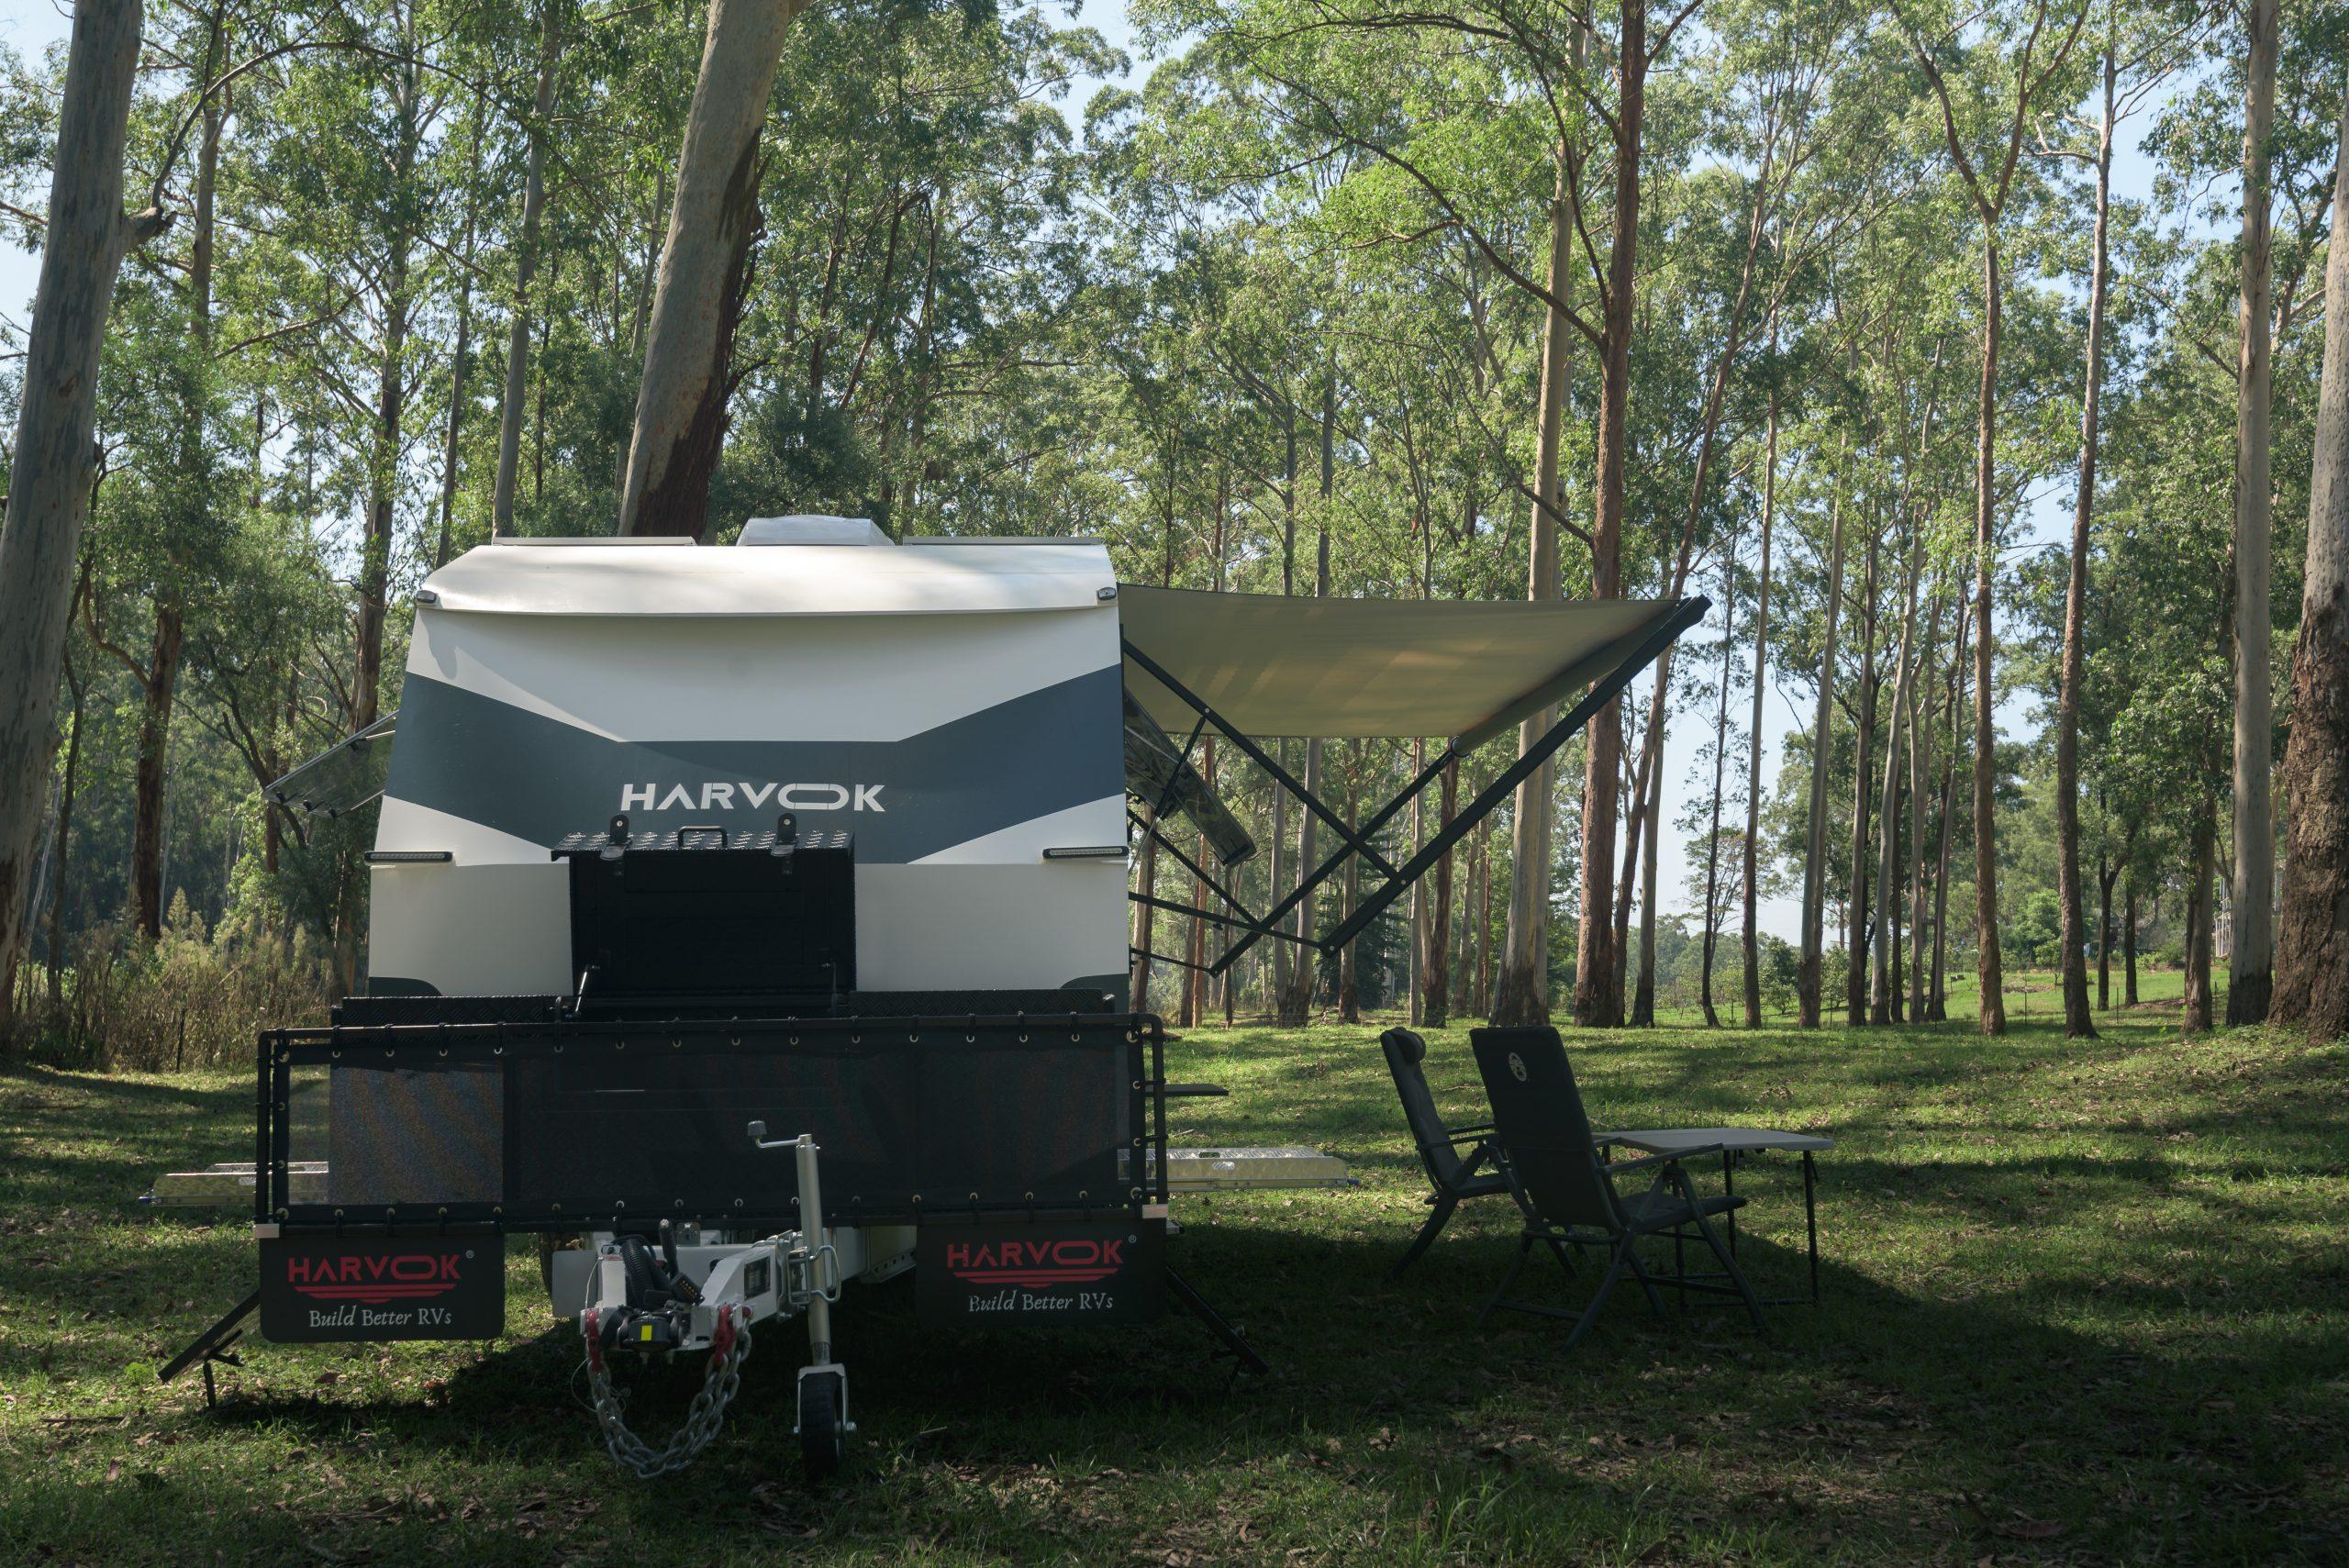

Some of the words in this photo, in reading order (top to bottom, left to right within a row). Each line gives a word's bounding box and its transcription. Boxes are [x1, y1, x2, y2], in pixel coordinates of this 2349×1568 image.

[620, 783, 885, 812] HARVOK
[947, 1240, 1123, 1268] HARVOK
[288, 1254, 462, 1283] HARVOK
[969, 1289, 1018, 1312] Build
[1022, 1293, 1074, 1311] Better
[1079, 1292, 1113, 1310] RVs
[309, 1305, 358, 1328] Build
[362, 1309, 412, 1327] Better
[417, 1307, 452, 1326] RVs
